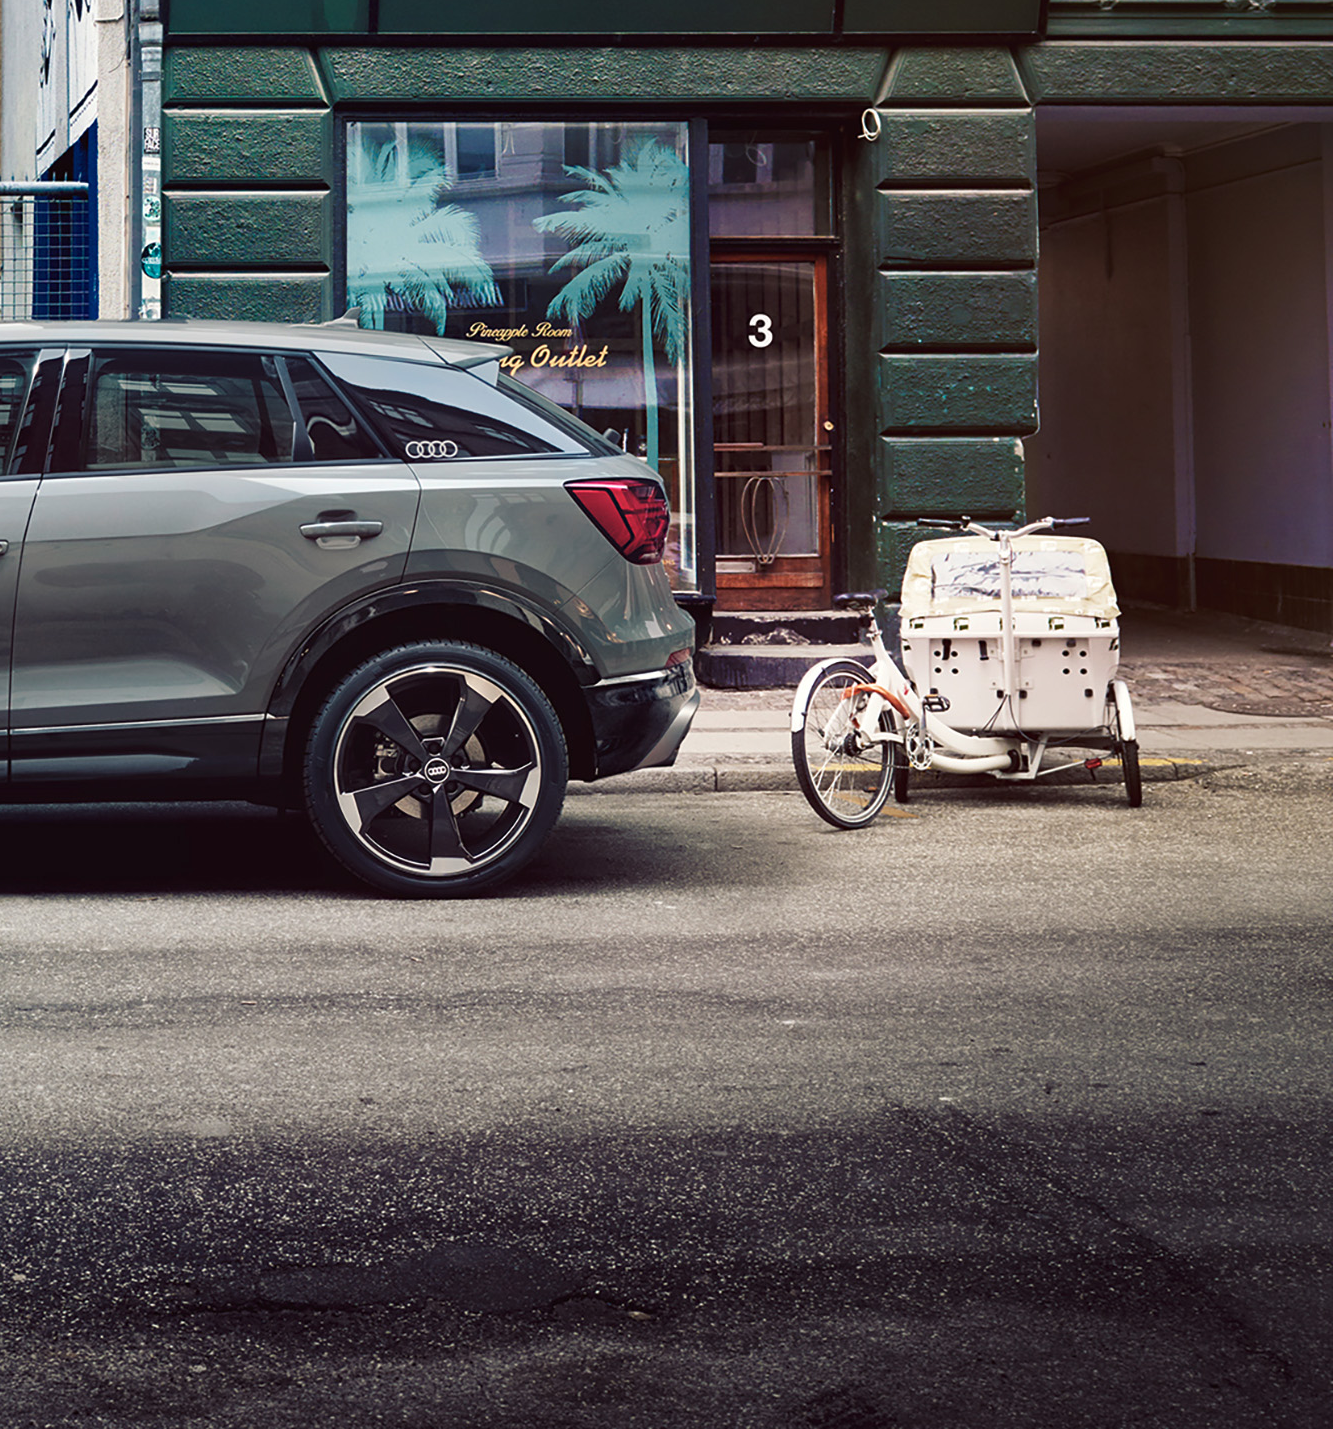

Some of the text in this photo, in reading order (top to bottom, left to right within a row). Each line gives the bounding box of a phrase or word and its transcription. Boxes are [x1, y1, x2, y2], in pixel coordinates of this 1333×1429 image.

[465, 321, 573, 341] Pineapple Room
[748, 313, 773, 348] 3
[530, 344, 609, 368] Outlet
